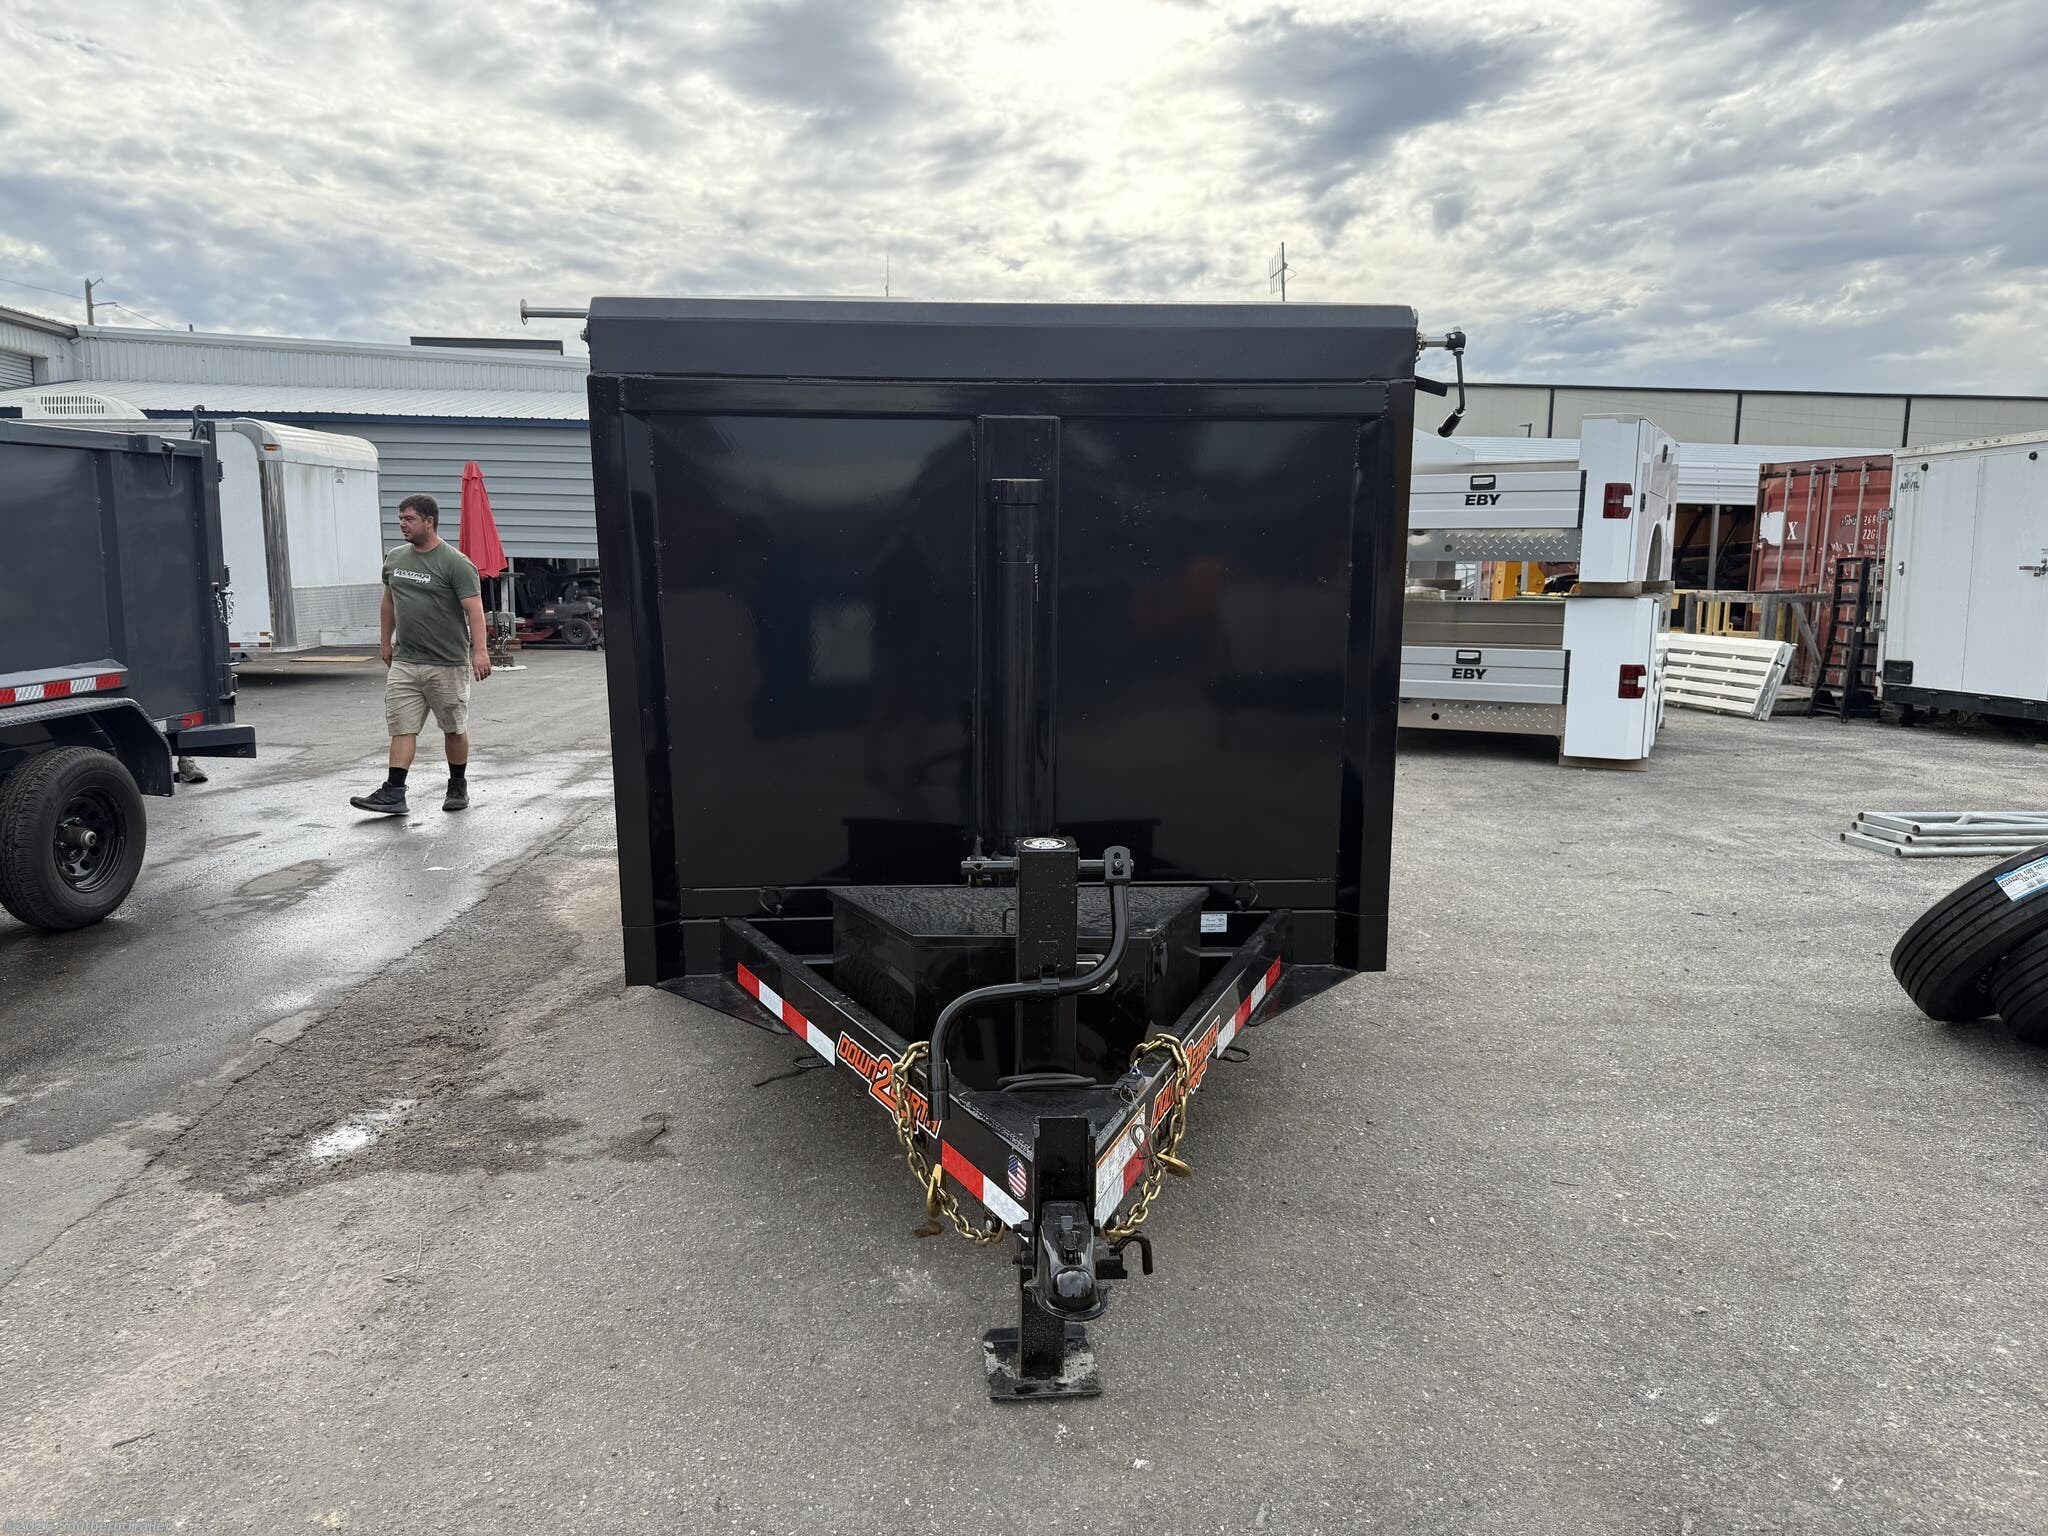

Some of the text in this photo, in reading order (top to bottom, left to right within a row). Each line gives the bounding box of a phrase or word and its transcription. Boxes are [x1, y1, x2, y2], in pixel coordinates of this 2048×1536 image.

[1465, 494, 1501, 506] EBY
[1786, 521, 1798, 540] X
[1452, 668, 1488, 680] EBY
